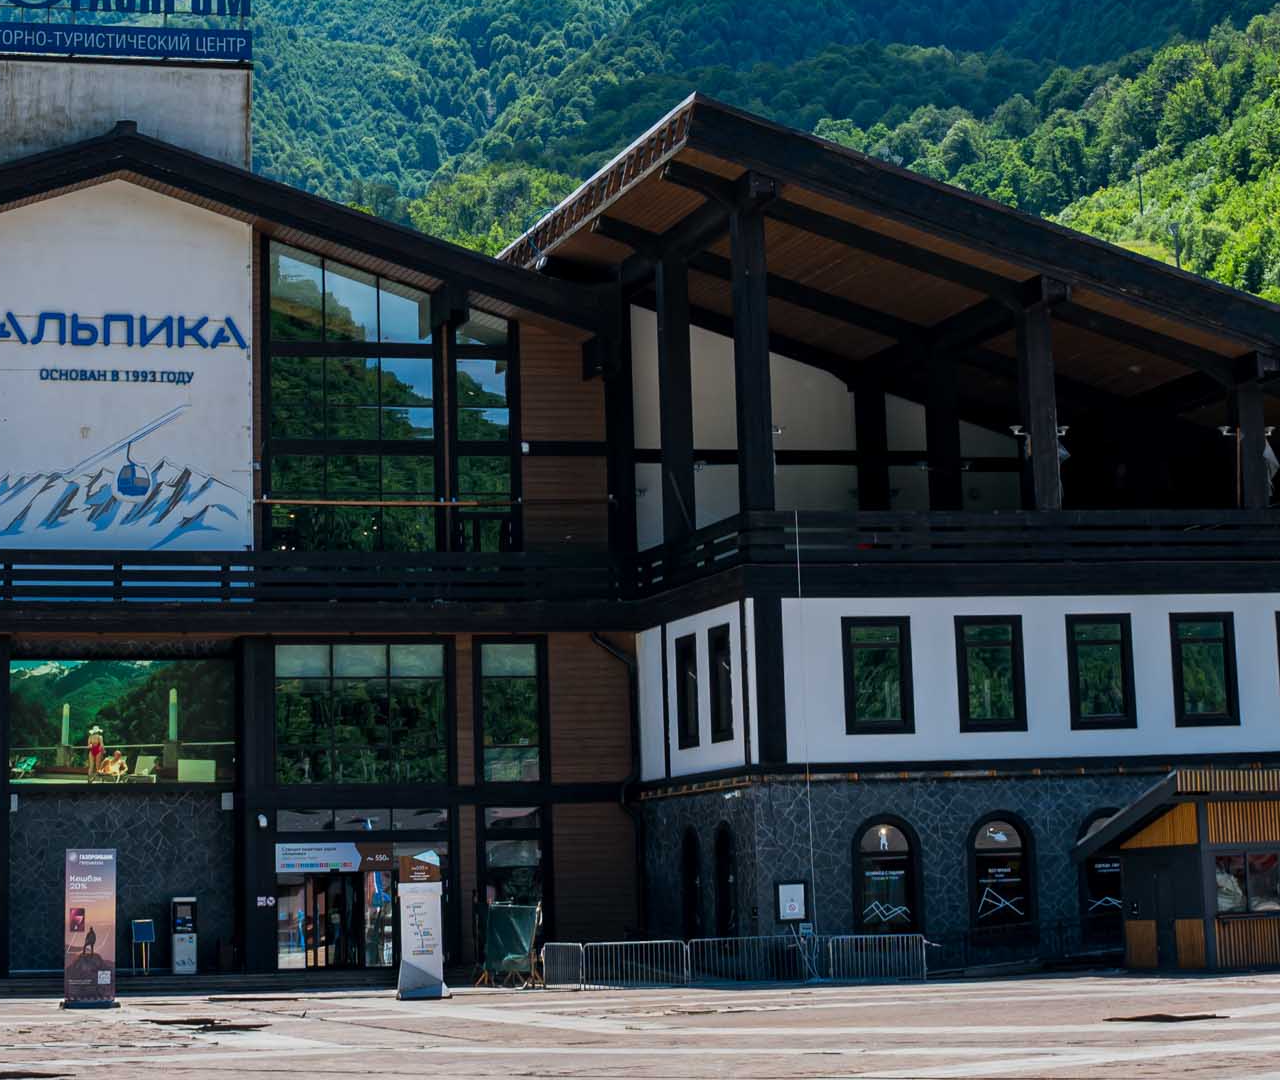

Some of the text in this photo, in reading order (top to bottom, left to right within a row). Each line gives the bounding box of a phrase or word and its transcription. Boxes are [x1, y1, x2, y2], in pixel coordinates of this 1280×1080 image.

[196, 37, 246, 54] ЦЕНТР
[39, 368, 194, 385] ОСНОВАН В 1993 ГОДУ
